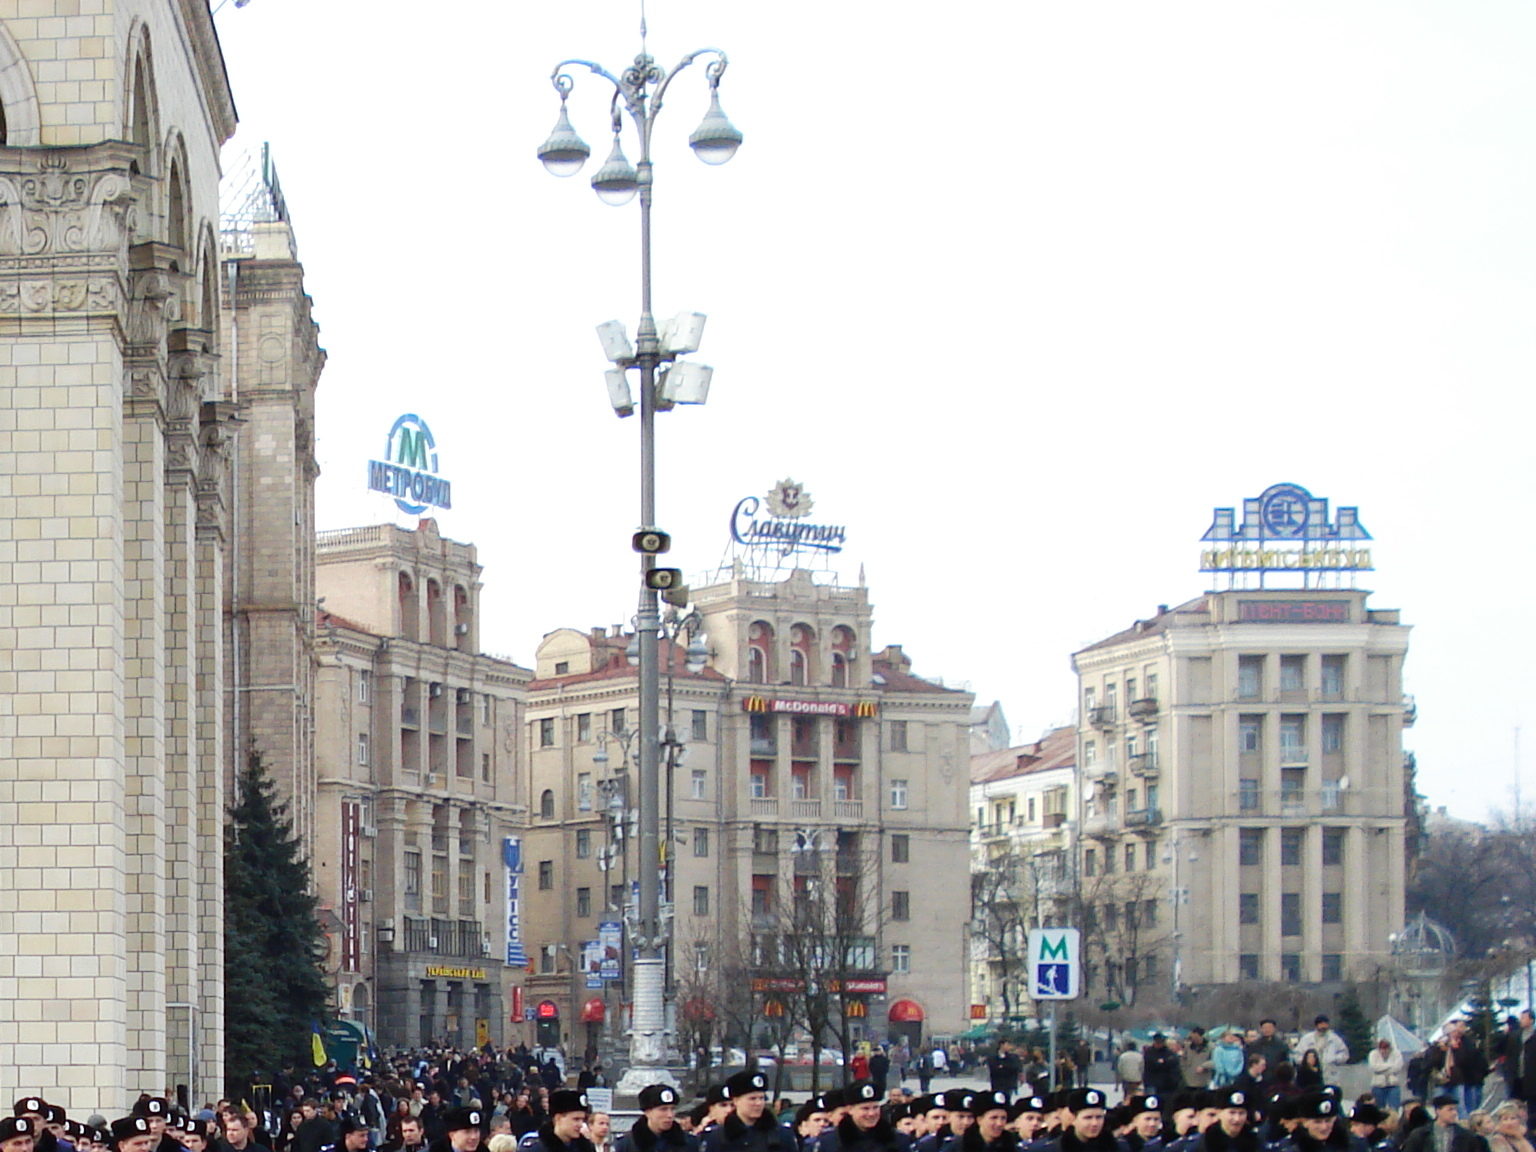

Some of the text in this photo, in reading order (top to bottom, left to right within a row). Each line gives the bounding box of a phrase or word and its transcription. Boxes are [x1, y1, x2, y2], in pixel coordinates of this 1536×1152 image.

[368, 459, 452, 510] МЕТРОБУД
[730, 496, 847, 556] Славутич
[774, 700, 846, 715] McDonald's
[1039, 934, 1069, 960] М
